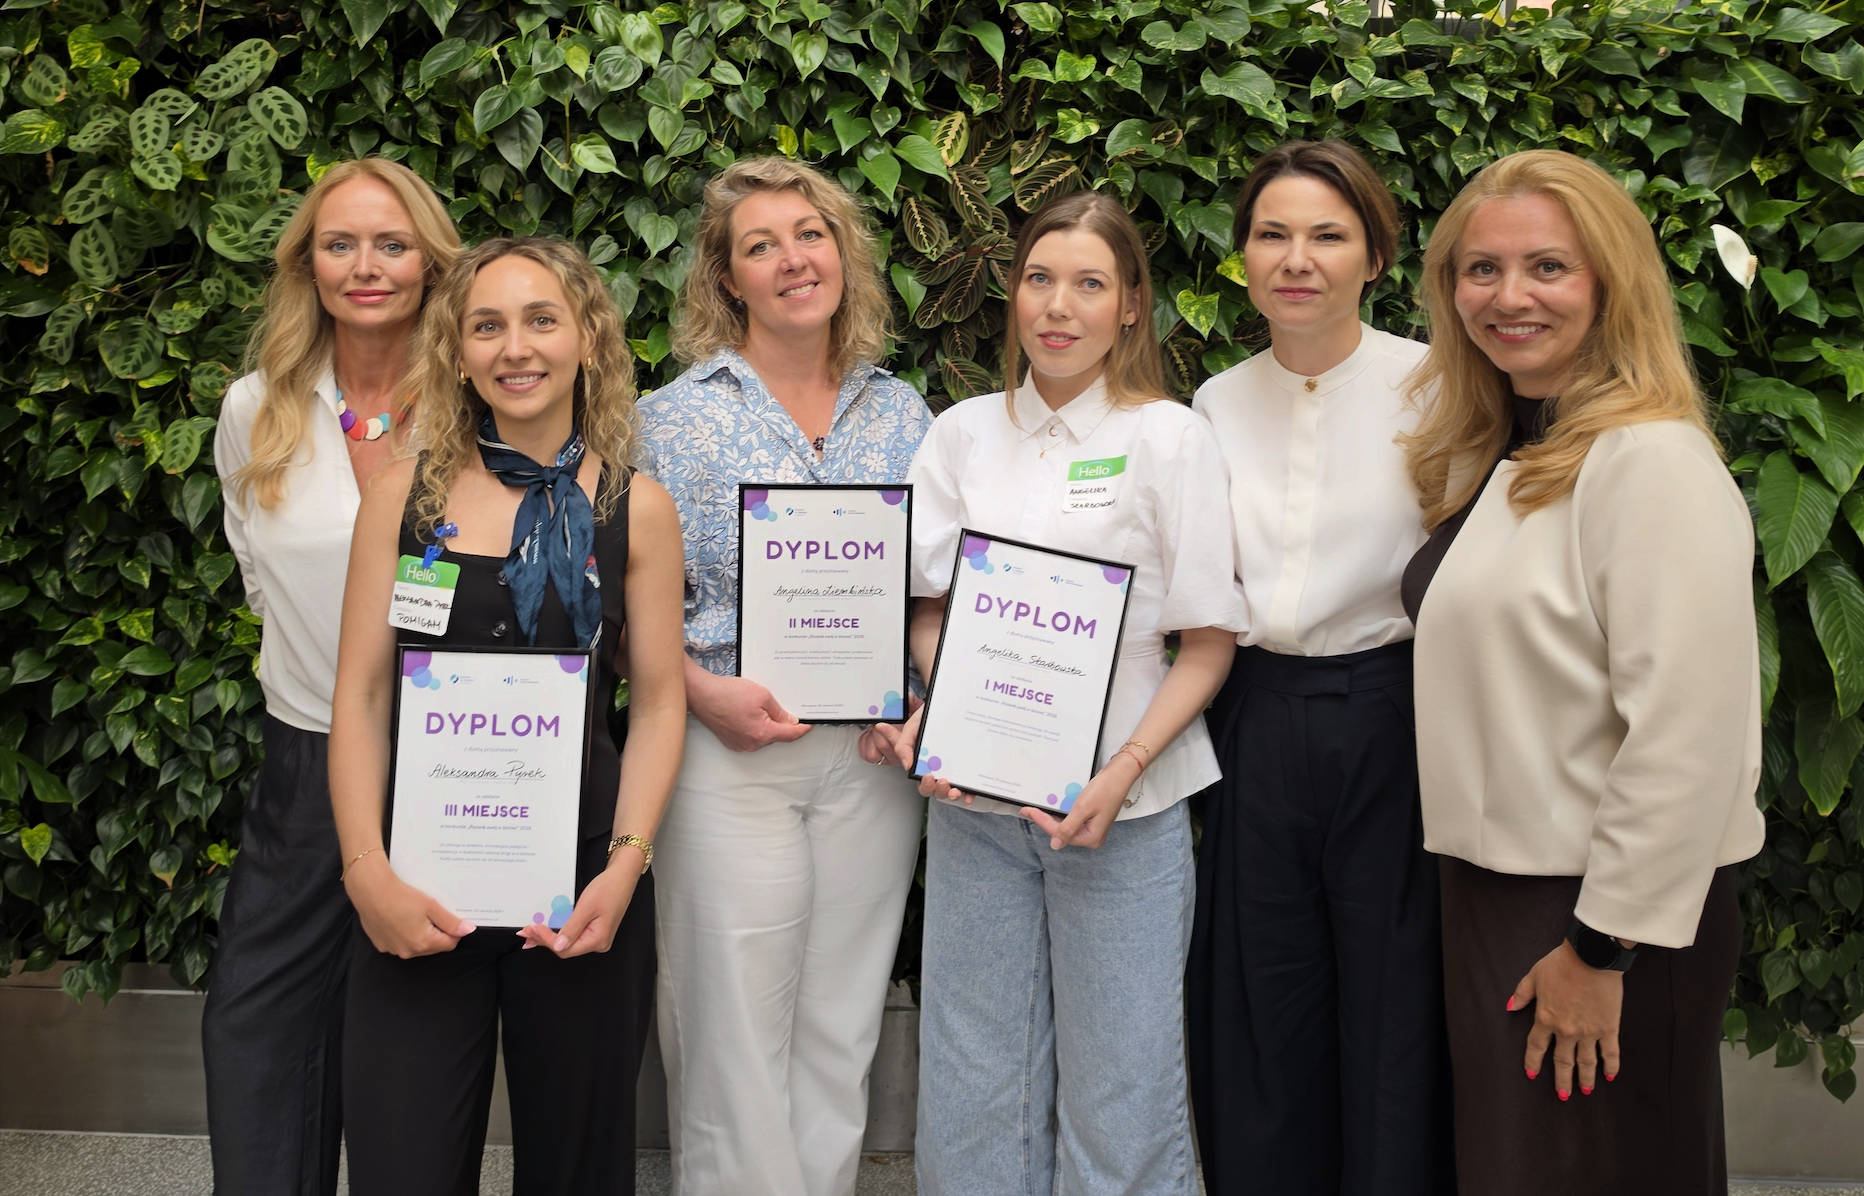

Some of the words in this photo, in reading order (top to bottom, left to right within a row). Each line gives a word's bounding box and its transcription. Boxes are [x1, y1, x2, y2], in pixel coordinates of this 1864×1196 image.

[1078, 465, 1110, 477] Hello
[1069, 487, 1107, 495] ANGELIKA
[766, 540, 884, 560] DYPLOM
[406, 564, 437, 583] Hello
[773, 585, 820, 603] Angelina
[789, 618, 797, 628] II
[800, 618, 860, 629] MIEJSCE
[974, 593, 1097, 639] DYPLOM
[978, 644, 1023, 660] Angelika
[985, 679, 990, 690] I
[993, 683, 1054, 705] MIEJSCE
[426, 712, 560, 737] DYPLOM
[428, 763, 499, 778] Aleksandra
[503, 760, 547, 785] Pyrek
[444, 804, 457, 816] III
[462, 804, 530, 818] MIEJSCE
